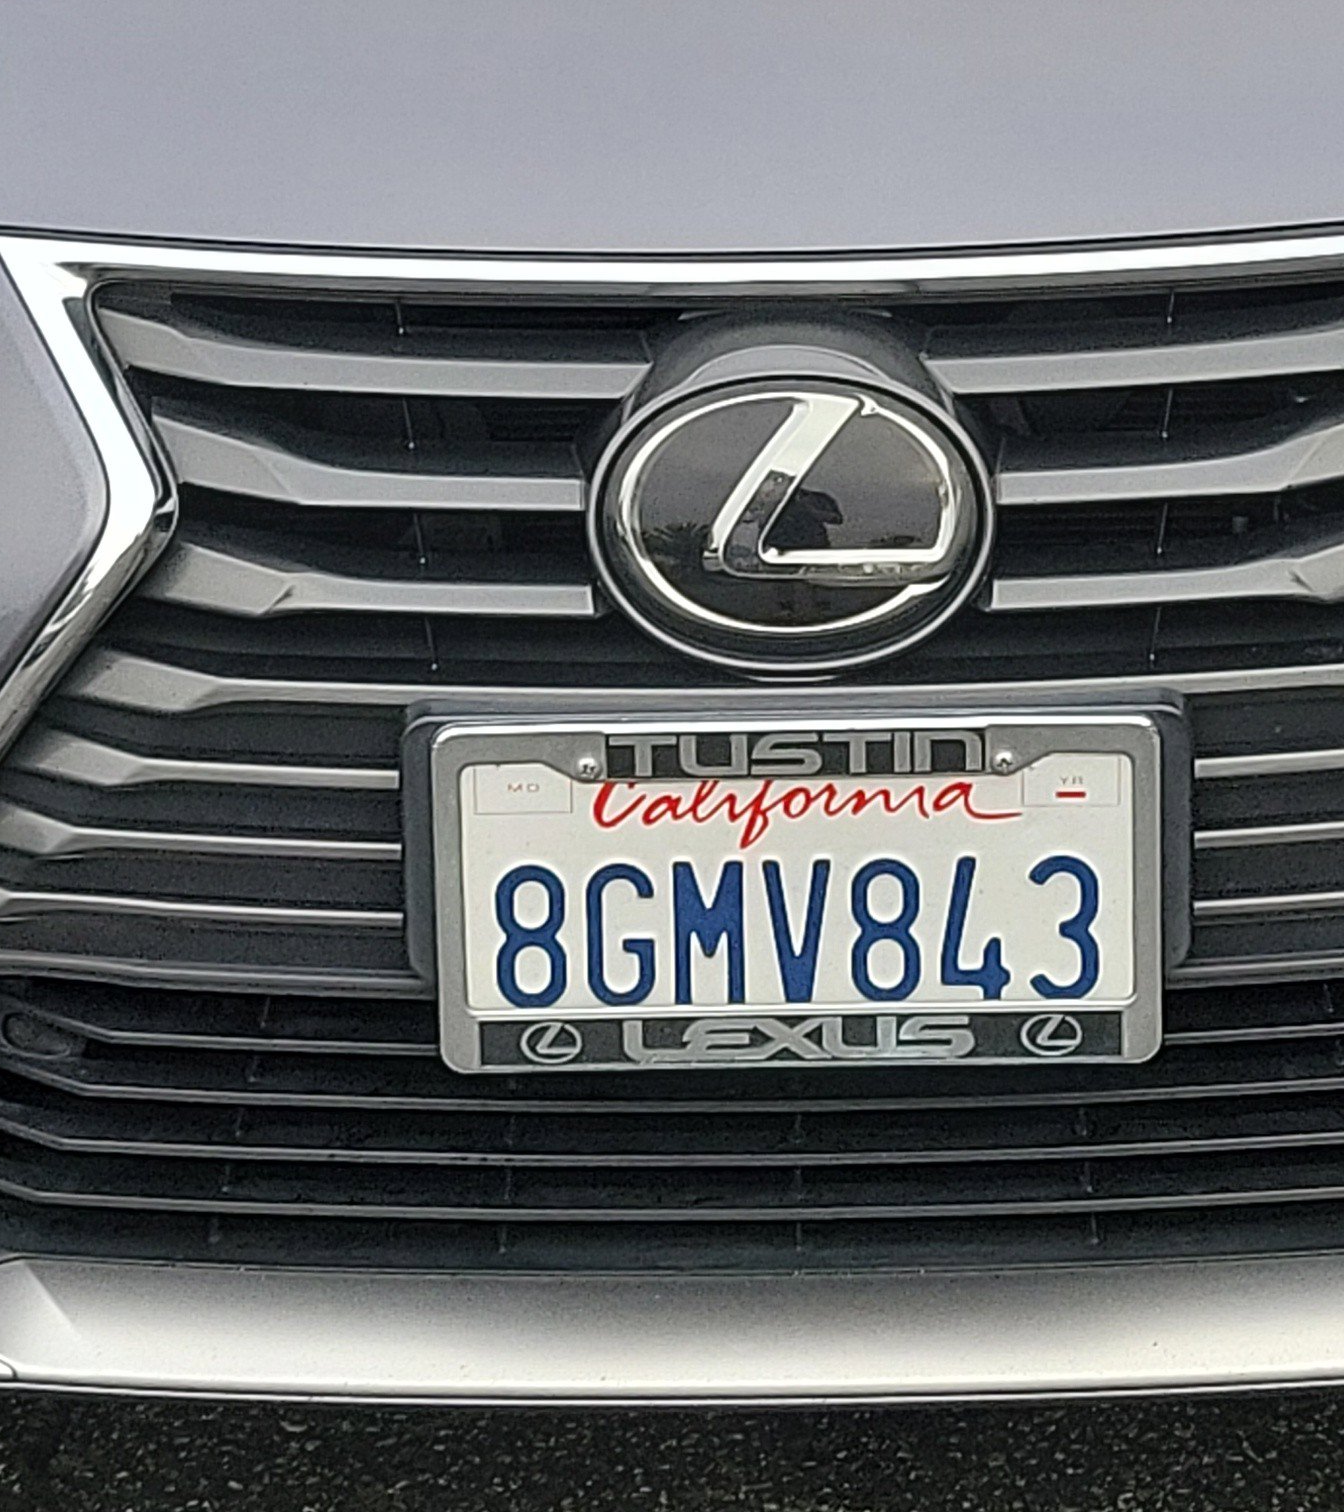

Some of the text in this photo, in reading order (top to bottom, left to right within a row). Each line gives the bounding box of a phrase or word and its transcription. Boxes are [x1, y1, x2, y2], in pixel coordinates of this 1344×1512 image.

[608, 730, 985, 779] TUSTIN
[592, 780, 1023, 849] California
[495, 855, 1100, 1008] 8GMV843
[622, 1014, 976, 1062] LEXUS
